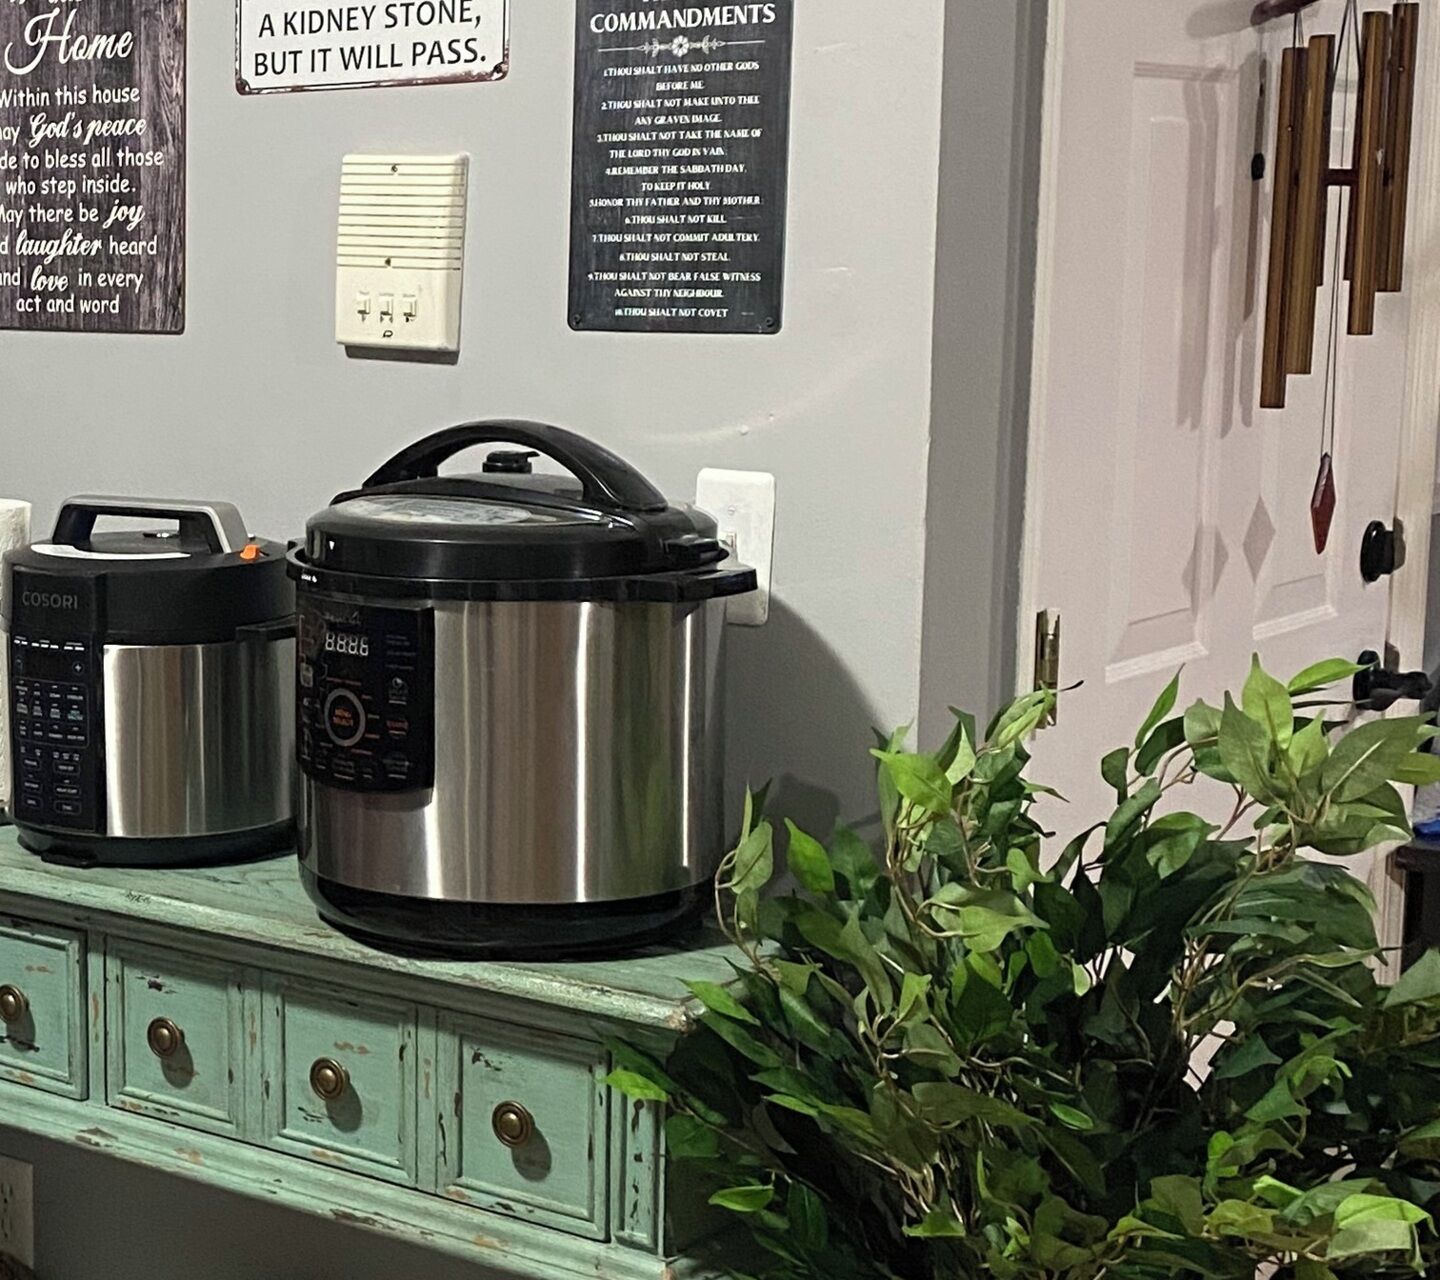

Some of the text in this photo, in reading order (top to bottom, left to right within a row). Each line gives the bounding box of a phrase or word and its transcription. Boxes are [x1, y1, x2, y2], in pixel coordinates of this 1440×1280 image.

[258, 13, 275, 38] A
[283, 5, 377, 37] KIDNEY
[590, 3, 776, 33] COMMANDMENTS
[4, 7, 134, 75] Home
[254, 37, 487, 77] BUT IT WILL PASS.
[633, 65, 662, 76] SHALT
[704, 61, 733, 72] OTHER
[735, 60, 760, 70] GODS
[656, 80, 688, 91] BEFORE
[54, 85, 87, 106] this
[92, 84, 141, 104] house
[633, 99, 662, 109] SHALT
[663, 98, 682, 108] NOT
[684, 97, 709, 108] MAKE
[710, 96, 736, 106] UNTO
[737, 95, 760, 105] THEE
[634, 114, 690, 126] ANY GRAVEN
[28, 111, 82, 148] God's
[82, 118, 147, 145] peace
[628, 132, 658, 142] SHALT
[659, 131, 676, 140] NOT
[679, 130, 702, 140] TAKE
[704, 130, 722, 138] THE
[724, 128, 750, 138] NAME
[750, 128, 762, 138] OF
[22, 152, 40, 169] to
[45, 148, 86, 169] bless
[91, 147, 111, 167] all
[116, 146, 164, 167] those
[610, 150, 626, 159] THE
[628, 148, 651, 158] LORD
[652, 148, 672, 158] THY
[672, 148, 690, 156] GOD
[661, 165, 678, 175] THE
[680, 164, 724, 174] SABBATH
[6, 172, 137, 200] who step inside.
[641, 182, 686, 192] TO KEEP IT
[626, 196, 644, 206] THY
[645, 196, 680, 206] FATHER
[682, 196, 702, 206] AND
[703, 196, 722, 206] THY
[28, 202, 74, 223] there
[79, 202, 99, 222] be
[102, 199, 146, 232] joy
[656, 214, 686, 224] SHALT
[687, 214, 706, 224] NOT
[623, 233, 652, 242] SHALT
[654, 233, 672, 242] NOT
[672, 233, 710, 242] COMMIT
[15, 228, 103, 264] laughter
[109, 234, 158, 255] heard
[650, 252, 680, 262] SHALT
[681, 252, 700, 262] NOT
[30, 265, 69, 292] love
[78, 269, 92, 287] in
[97, 273, 144, 294] every
[618, 272, 647, 282] SHALT
[648, 272, 667, 282] NOT
[668, 272, 692, 282] BEAR
[693, 272, 721, 282] FALSE
[722, 272, 762, 282] WITNESS
[614, 288, 672, 298] AGAINST THY
[16, 294, 120, 314] act and word
[648, 308, 678, 318] SHALT
[678, 308, 696, 318] NOT
[22, 591, 78, 610] COSORI
